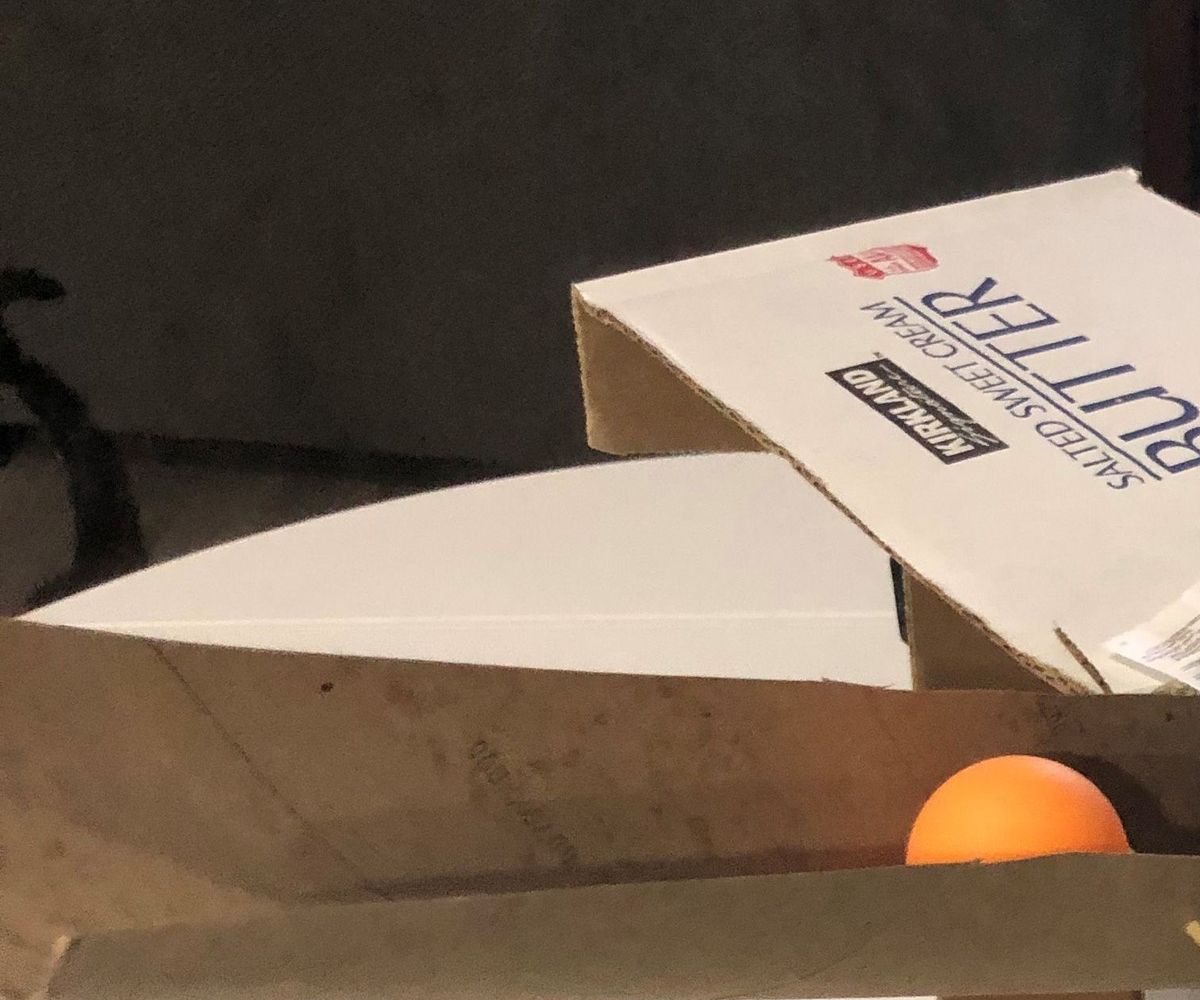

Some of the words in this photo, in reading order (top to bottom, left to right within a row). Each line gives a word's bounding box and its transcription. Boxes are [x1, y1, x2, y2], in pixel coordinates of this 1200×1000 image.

[860, 300, 958, 359] CREAM
[842, 368, 976, 457] KIRKLAND
[943, 362, 1047, 419] SWEET
[1036, 420, 1145, 491] SALTED
